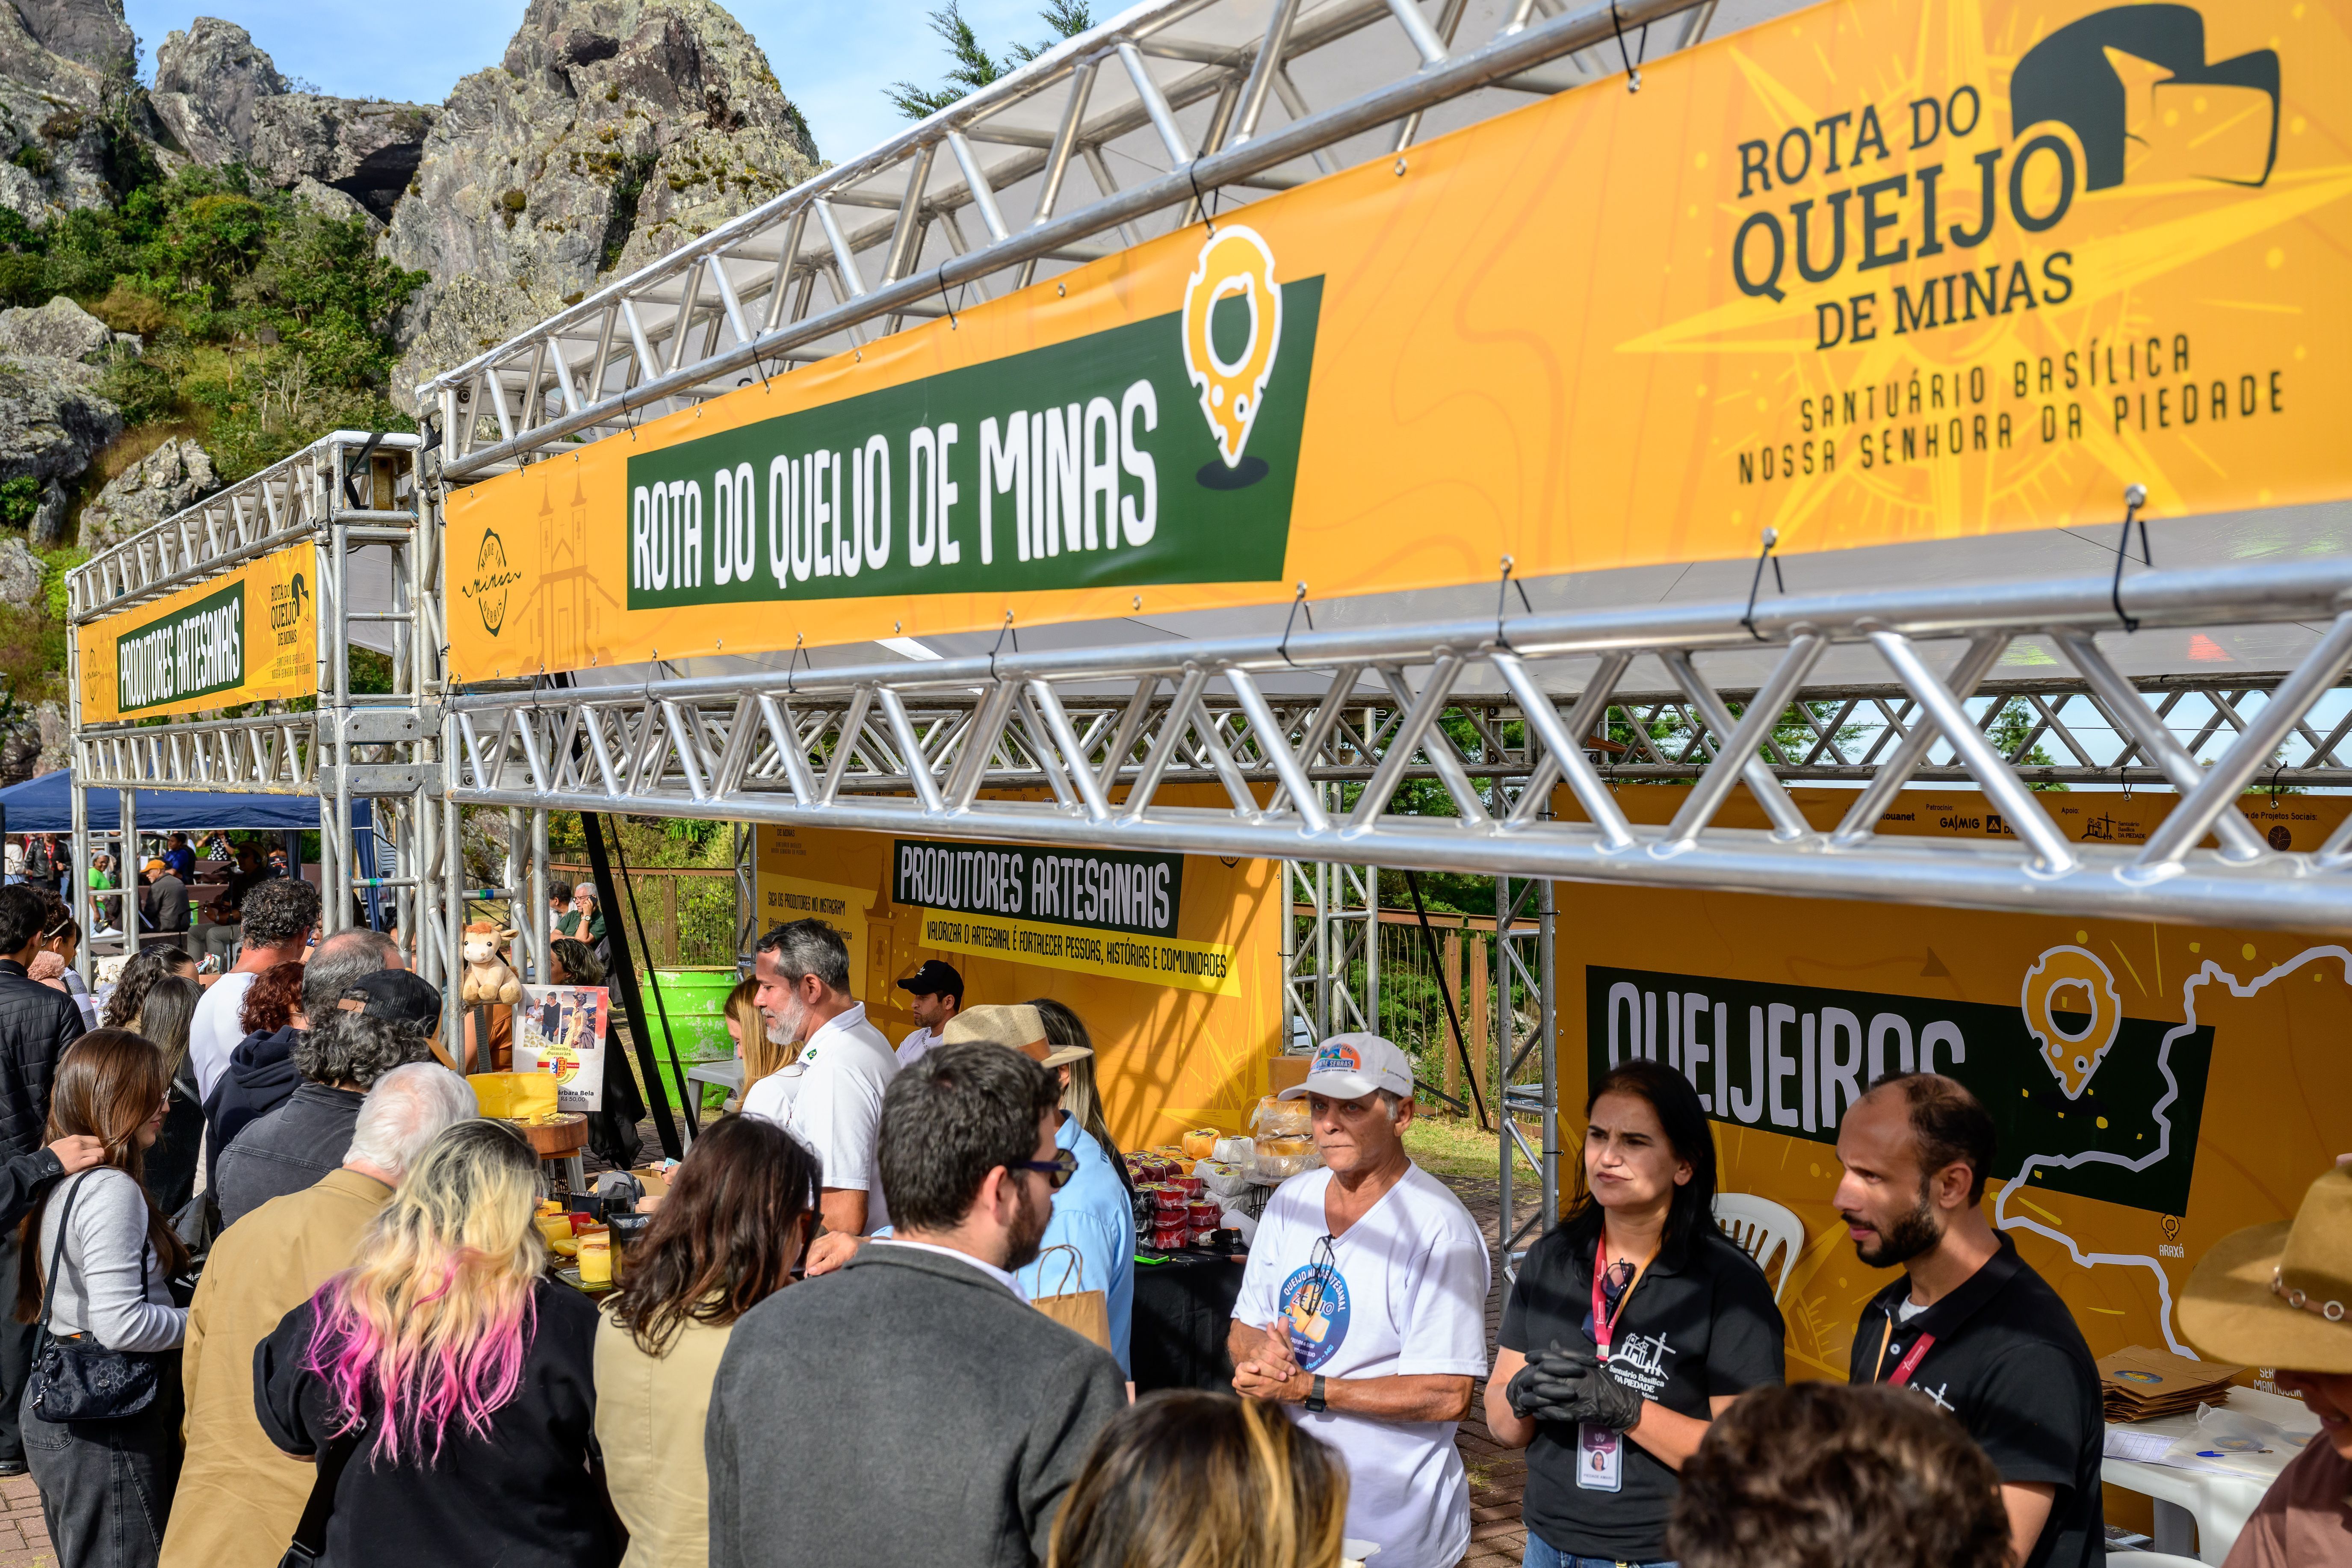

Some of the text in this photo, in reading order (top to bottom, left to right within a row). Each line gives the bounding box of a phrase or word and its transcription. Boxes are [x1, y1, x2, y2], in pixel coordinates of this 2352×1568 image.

[1737, 84, 1980, 199] ROTA DO
[1733, 135, 2075, 303] QUEIJO
[1815, 251, 2074, 350] DE MINAS
[1800, 333, 2190, 432] SANTUÁRIO BASÍLICA
[1739, 370, 2284, 485] NOSSA SENHORA DA PIEDADE
[634, 378, 1158, 591] ROTA DO QUEIJO DE MINAS
[481, 543, 502, 570] MADE IN
[271, 584, 290, 602] ROTA DO
[271, 600, 297, 631] QUEIJO
[483, 599, 502, 623] GERAIS
[278, 629, 297, 646] DE MINAS
[120, 596, 239, 708] PRODUTORES ARTESANAIS
[2061, 806, 2080, 815] Apoio:
[2261, 812, 2289, 821] Projetos
[2291, 812, 2317, 821] Sociais:
[783, 829, 795, 837] MINAS
[900, 846, 1170, 929] PRODUTORES ARTESANAIS
[768, 891, 845, 916] SIGA OS PRODUTORES NO INSTAGRAM
[927, 921, 1226, 978] VALORIZAR O ARTESANAL É FORTALECER PESSOAS, HISTÓRIAS E COMUNIDADES
[2159, 1243, 2184, 1258] ARAXÁ
[1284, 1271, 1307, 1296] QUEIJO
[1308, 1268, 1330, 1279] MIAS
[1305, 1357, 1322, 1370] rbara
[1609, 1364, 1664, 1387] Santuário Basílica
[2260, 1367, 2275, 1379] SER
[1623, 1377, 1655, 1393] PIEDADE
[1642, 1391, 1658, 1400] Minas
